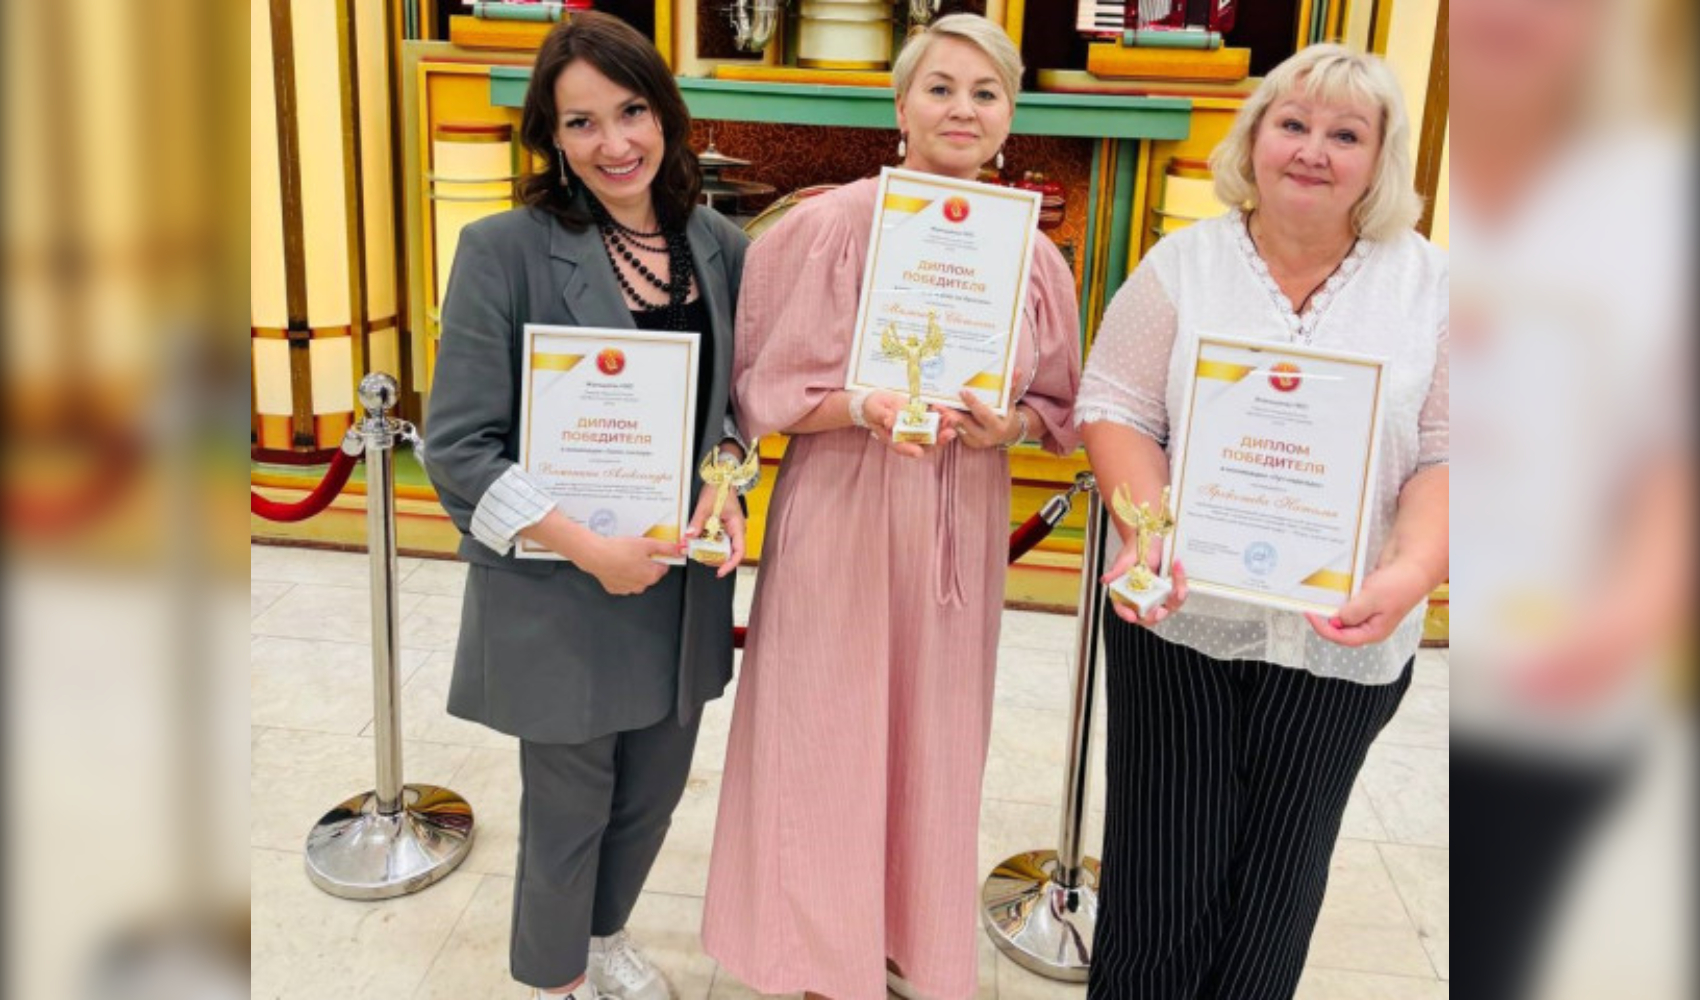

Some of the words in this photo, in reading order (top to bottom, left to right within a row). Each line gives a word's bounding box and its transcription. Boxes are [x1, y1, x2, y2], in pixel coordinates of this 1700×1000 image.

[917, 260, 975, 277] ДИПЛОМ
[903, 271, 986, 293] ПОБЕДИТЕЛЯ
[577, 417, 638, 429] ДИПЛОМ
[562, 431, 652, 445] ПОБЕДИТЕЛЯ
[1240, 435, 1311, 456] ДИПЛОМ
[1222, 447, 1326, 475] ПОБЕДИТЕЛЯ
